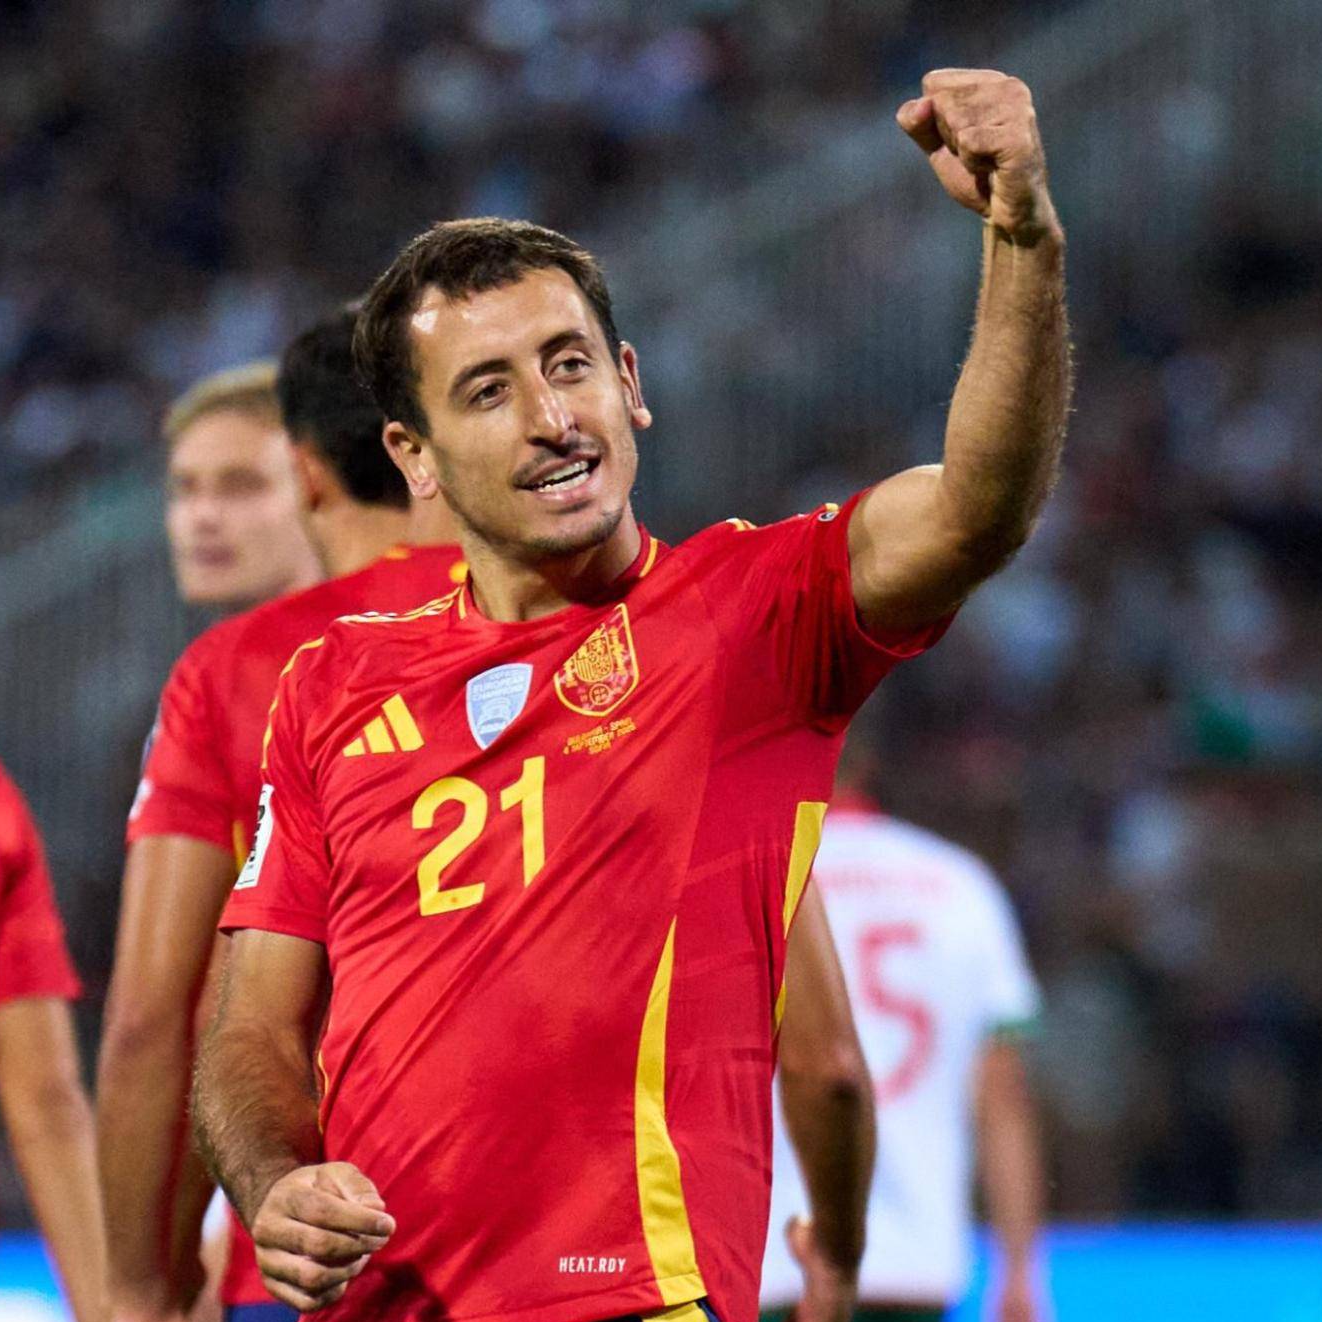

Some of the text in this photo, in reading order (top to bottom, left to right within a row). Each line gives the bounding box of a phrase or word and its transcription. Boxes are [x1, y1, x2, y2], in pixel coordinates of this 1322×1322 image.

[411, 755, 546, 917] 21
[858, 921, 936, 1106] 5
[559, 1256, 627, 1273] HEAT.RDY
